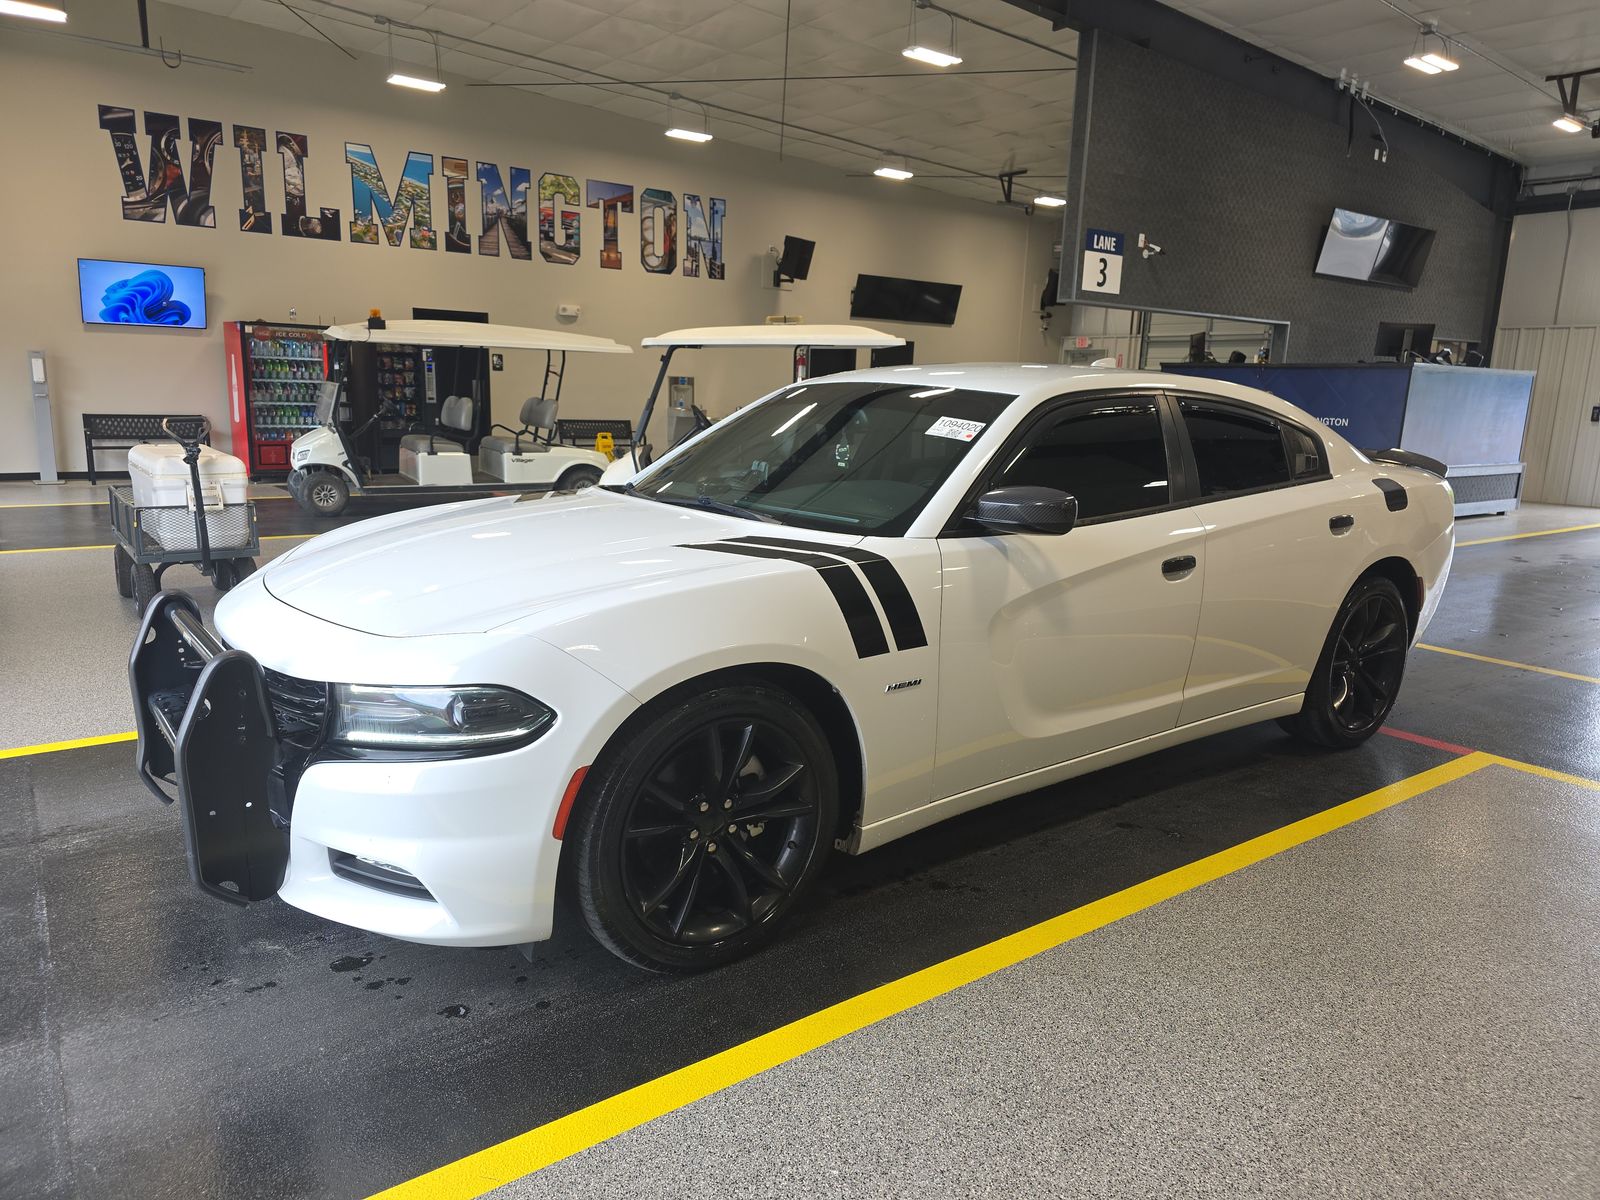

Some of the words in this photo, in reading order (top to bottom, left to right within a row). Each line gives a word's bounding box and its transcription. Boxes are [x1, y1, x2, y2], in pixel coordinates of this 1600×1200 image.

[98, 104, 726, 280] WILMINGTON
[1093, 233, 1117, 252] LANE
[1096, 257, 1108, 288] 3
[938, 419, 983, 433] 1094020
[884, 678, 922, 693] HEMI
